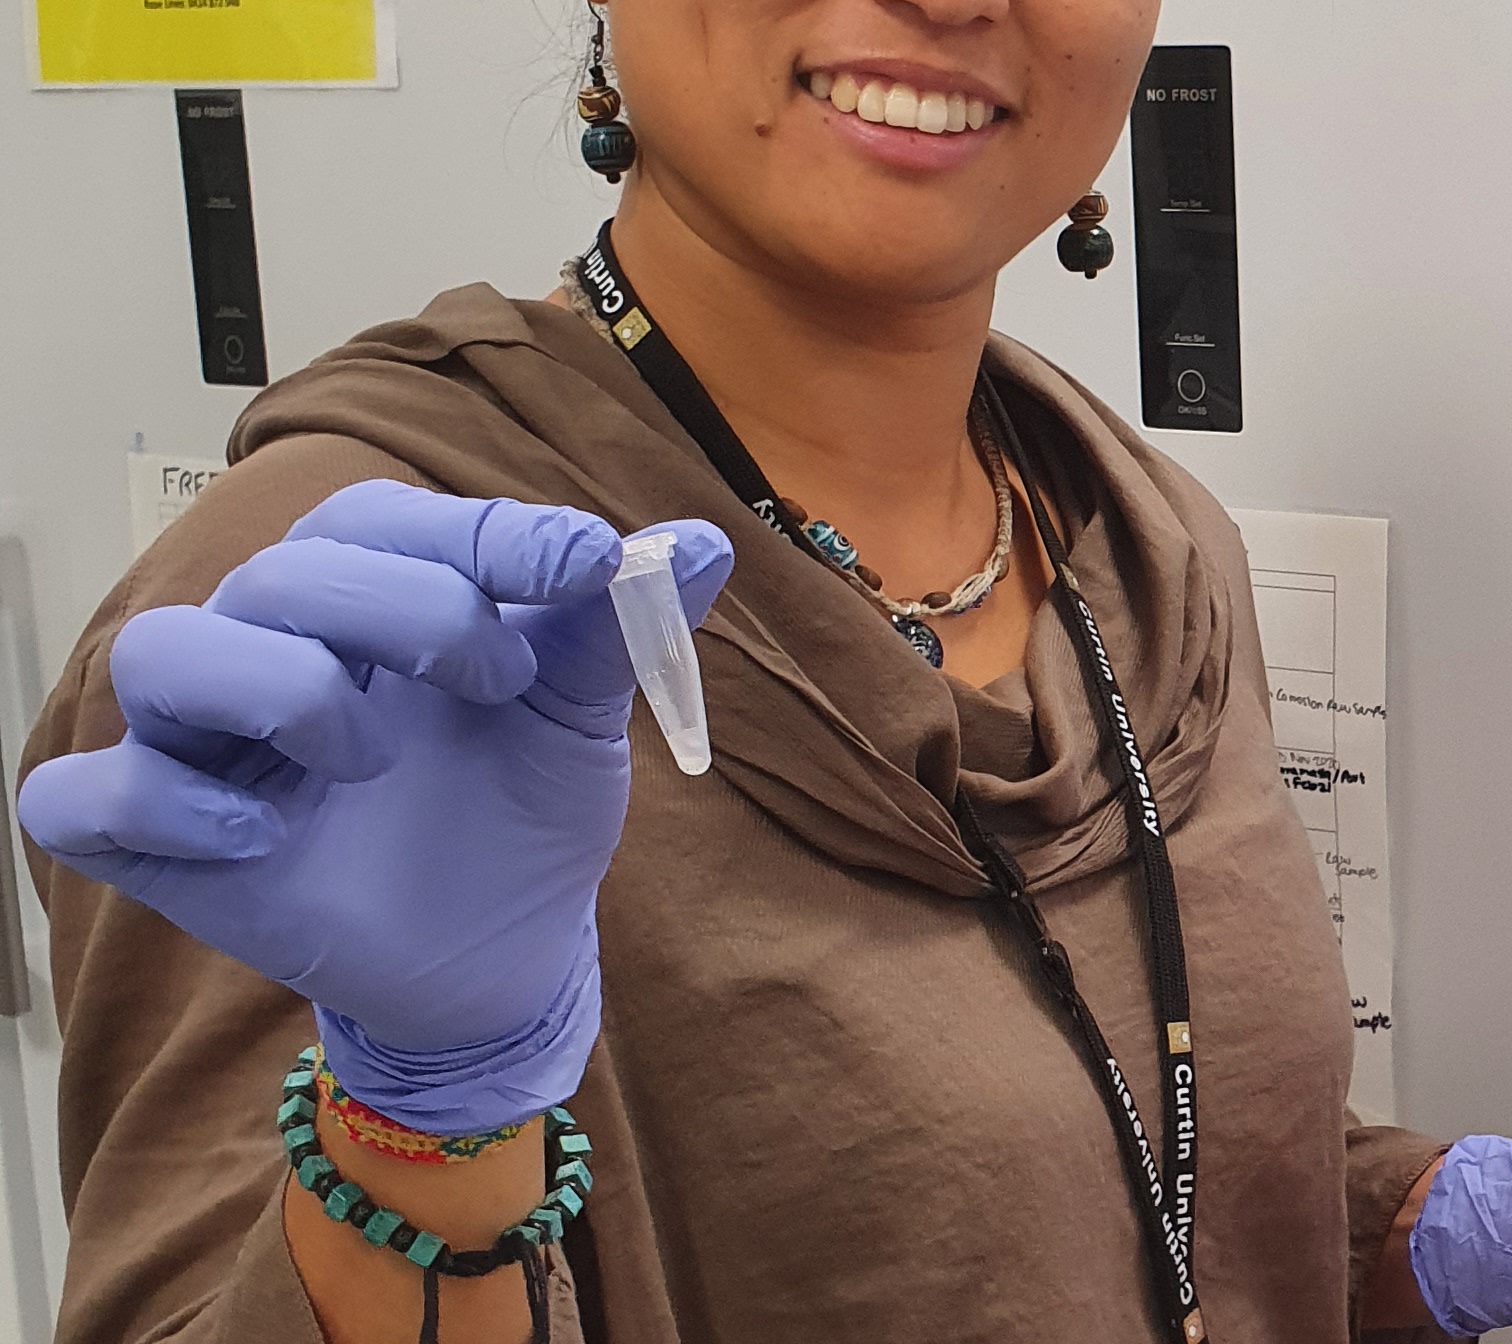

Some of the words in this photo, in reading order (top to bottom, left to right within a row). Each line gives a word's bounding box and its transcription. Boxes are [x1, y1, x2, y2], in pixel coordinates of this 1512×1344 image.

[1146, 89, 1166, 102] NO
[1171, 88, 1217, 102] FROST
[584, 248, 624, 313] Curtin
[163, 467, 219, 496] FRE
[1078, 600, 1113, 682] Curtin
[1112, 693, 1160, 837] University
[1107, 1058, 1163, 1207] University
[1174, 1064, 1195, 1160] Curtin
[1163, 1212, 1193, 1305] Curtin
